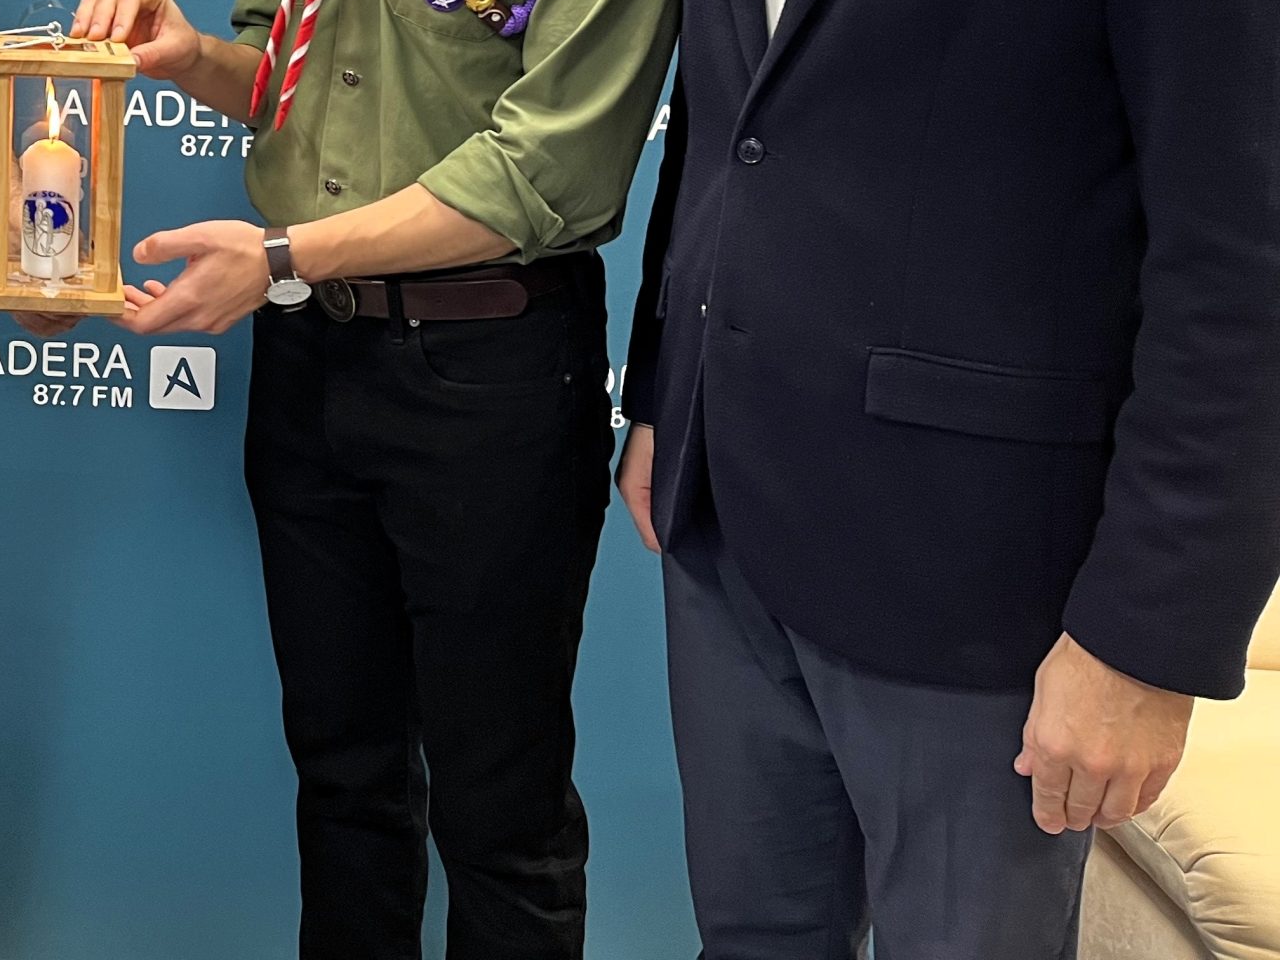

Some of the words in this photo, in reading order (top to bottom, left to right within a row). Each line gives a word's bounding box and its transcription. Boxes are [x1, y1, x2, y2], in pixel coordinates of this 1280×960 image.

[180, 134, 234, 157] 87.7
[32, 383, 85, 407] 87.7
[92, 385, 133, 408] FM
